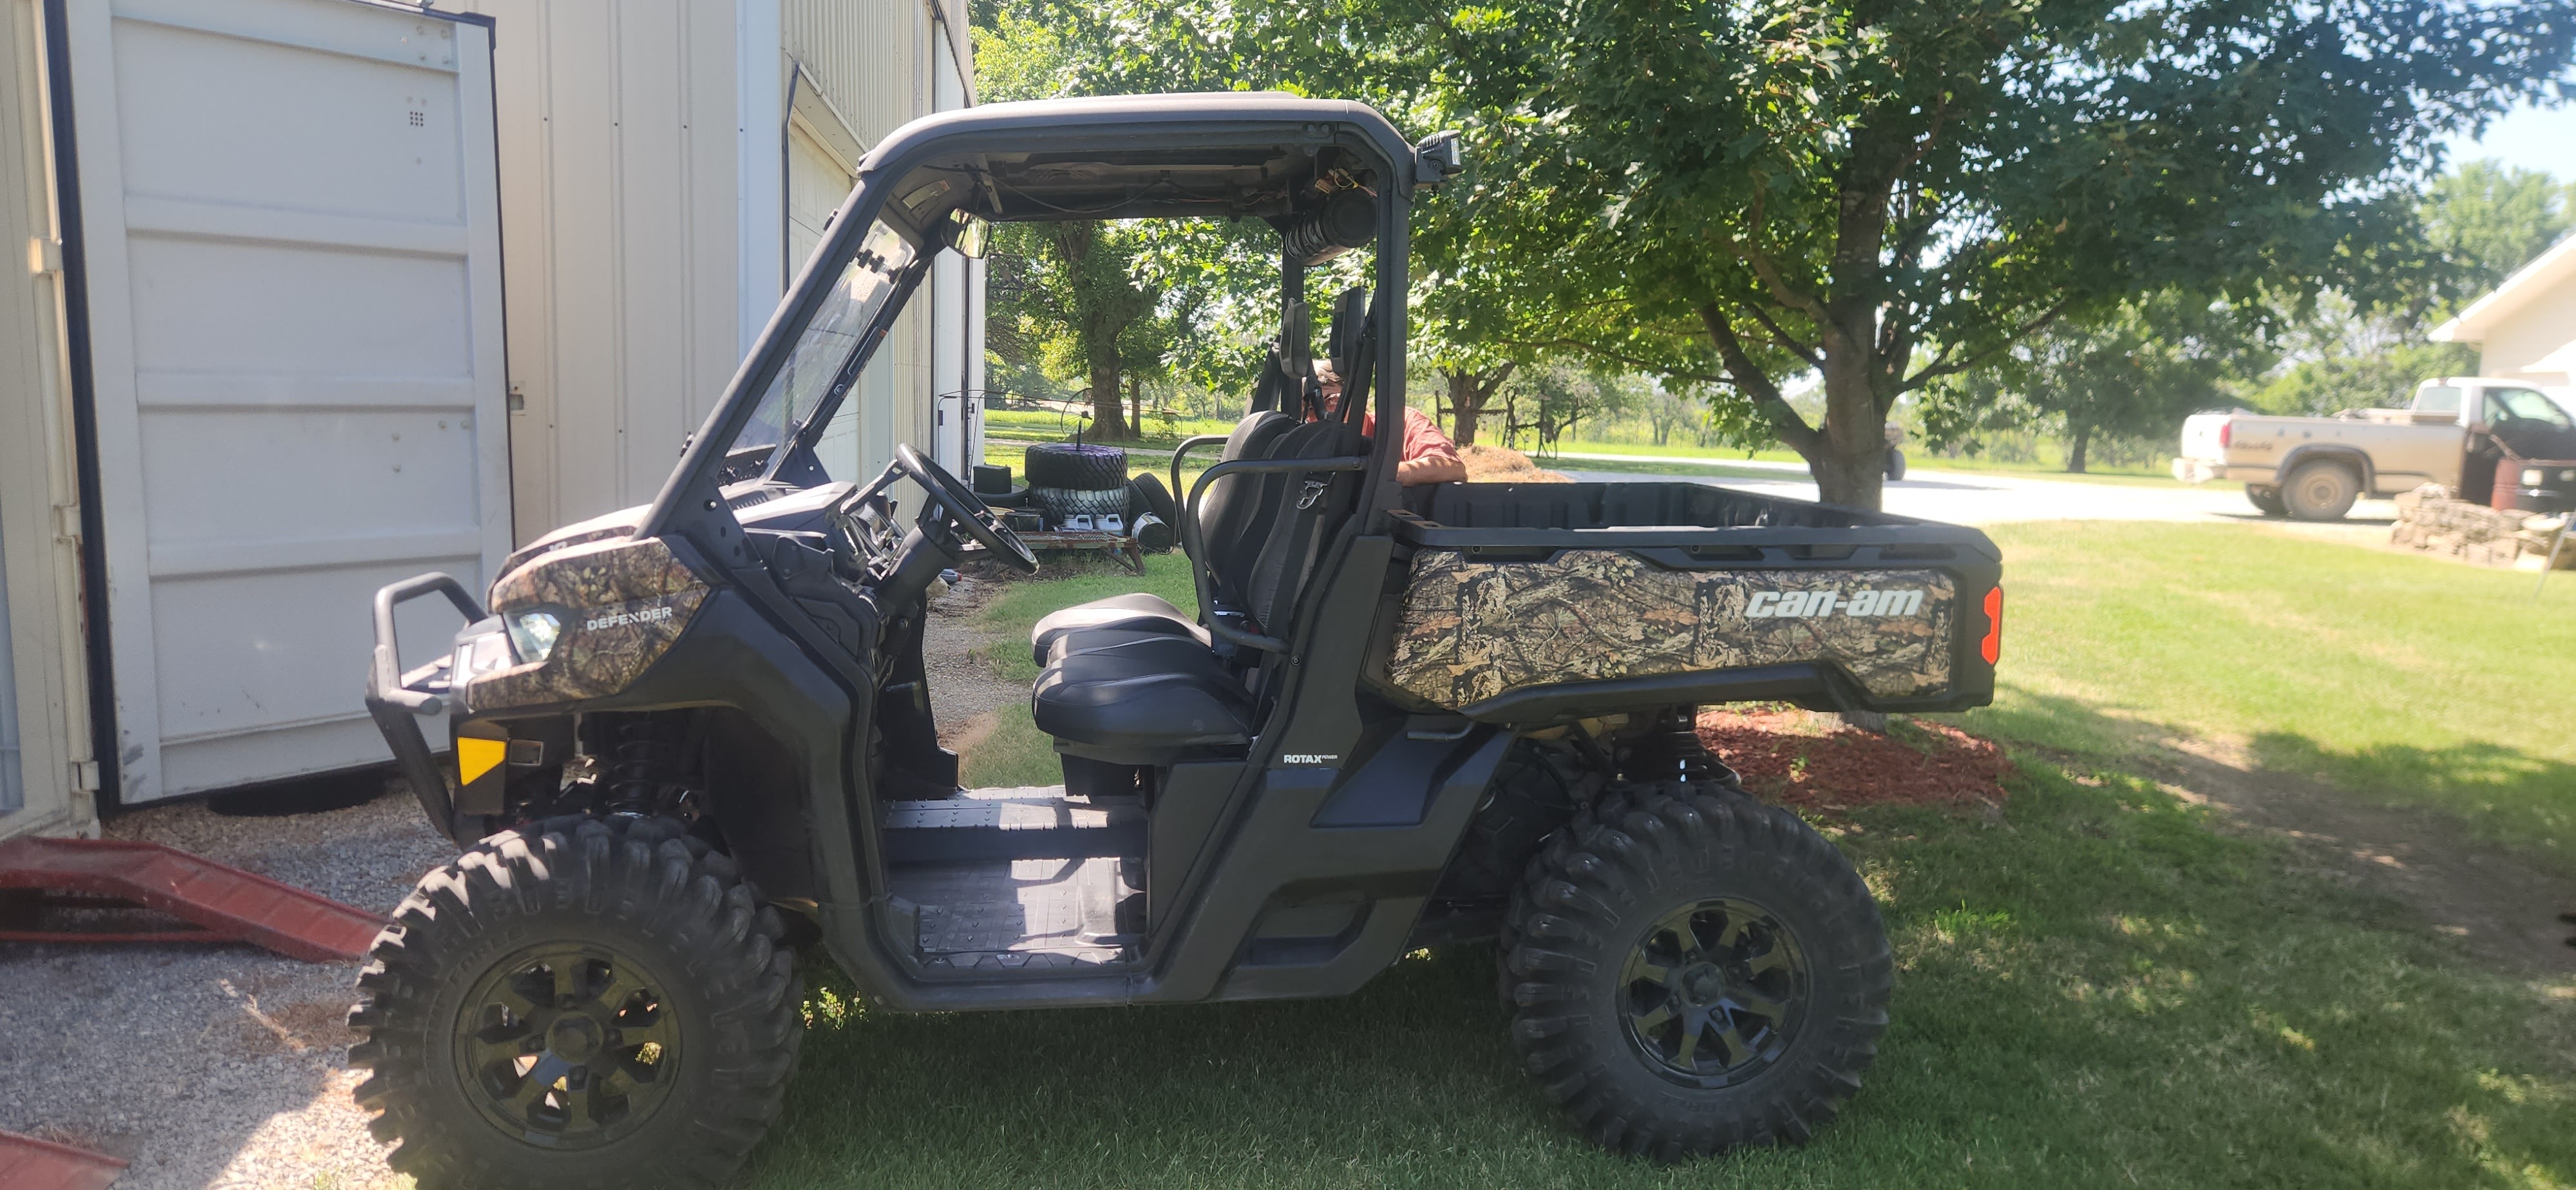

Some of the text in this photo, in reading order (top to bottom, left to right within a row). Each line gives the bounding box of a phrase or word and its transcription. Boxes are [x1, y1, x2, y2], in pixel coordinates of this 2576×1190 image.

[1745, 589, 1924, 618] can-am
[587, 607, 672, 631] DEFENDER
[1283, 755, 1322, 764] ROTAX
